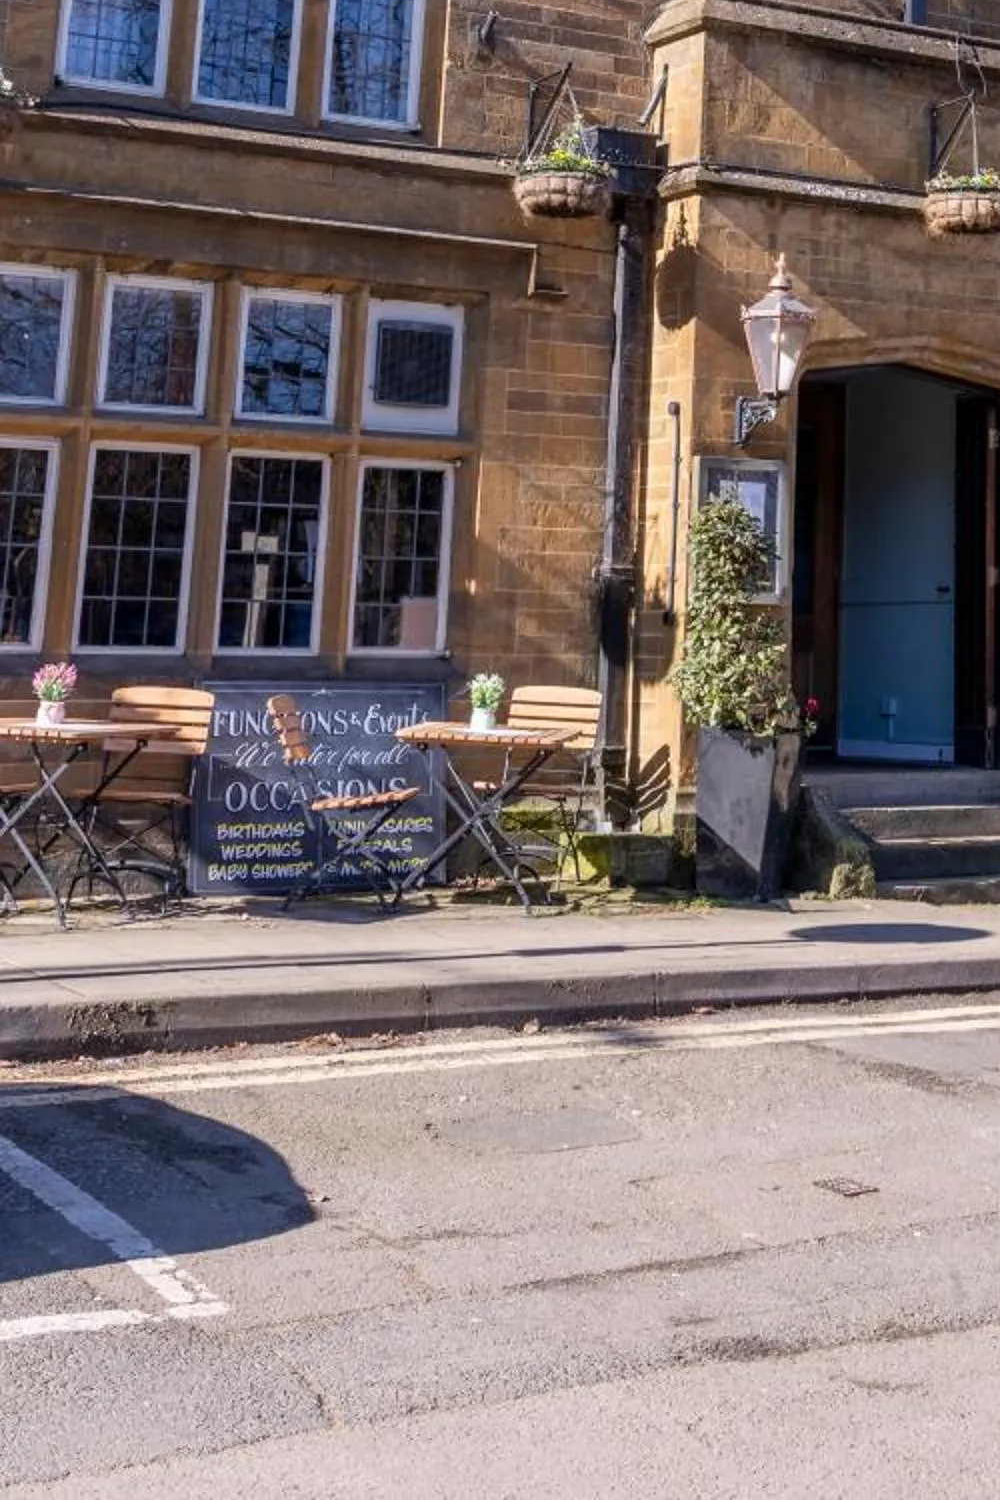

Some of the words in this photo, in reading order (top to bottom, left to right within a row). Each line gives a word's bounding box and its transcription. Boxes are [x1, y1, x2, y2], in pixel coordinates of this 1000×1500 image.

[213, 709, 349, 737] FUNCONS
[234, 741, 276, 768] We
[216, 822, 305, 840] BIRTHDAYS
[327, 816, 433, 836] ANNIRSARIES
[221, 841, 303, 860] WEDDINGS
[336, 838, 413, 855] FERALS
[207, 863, 248, 881] BABY
